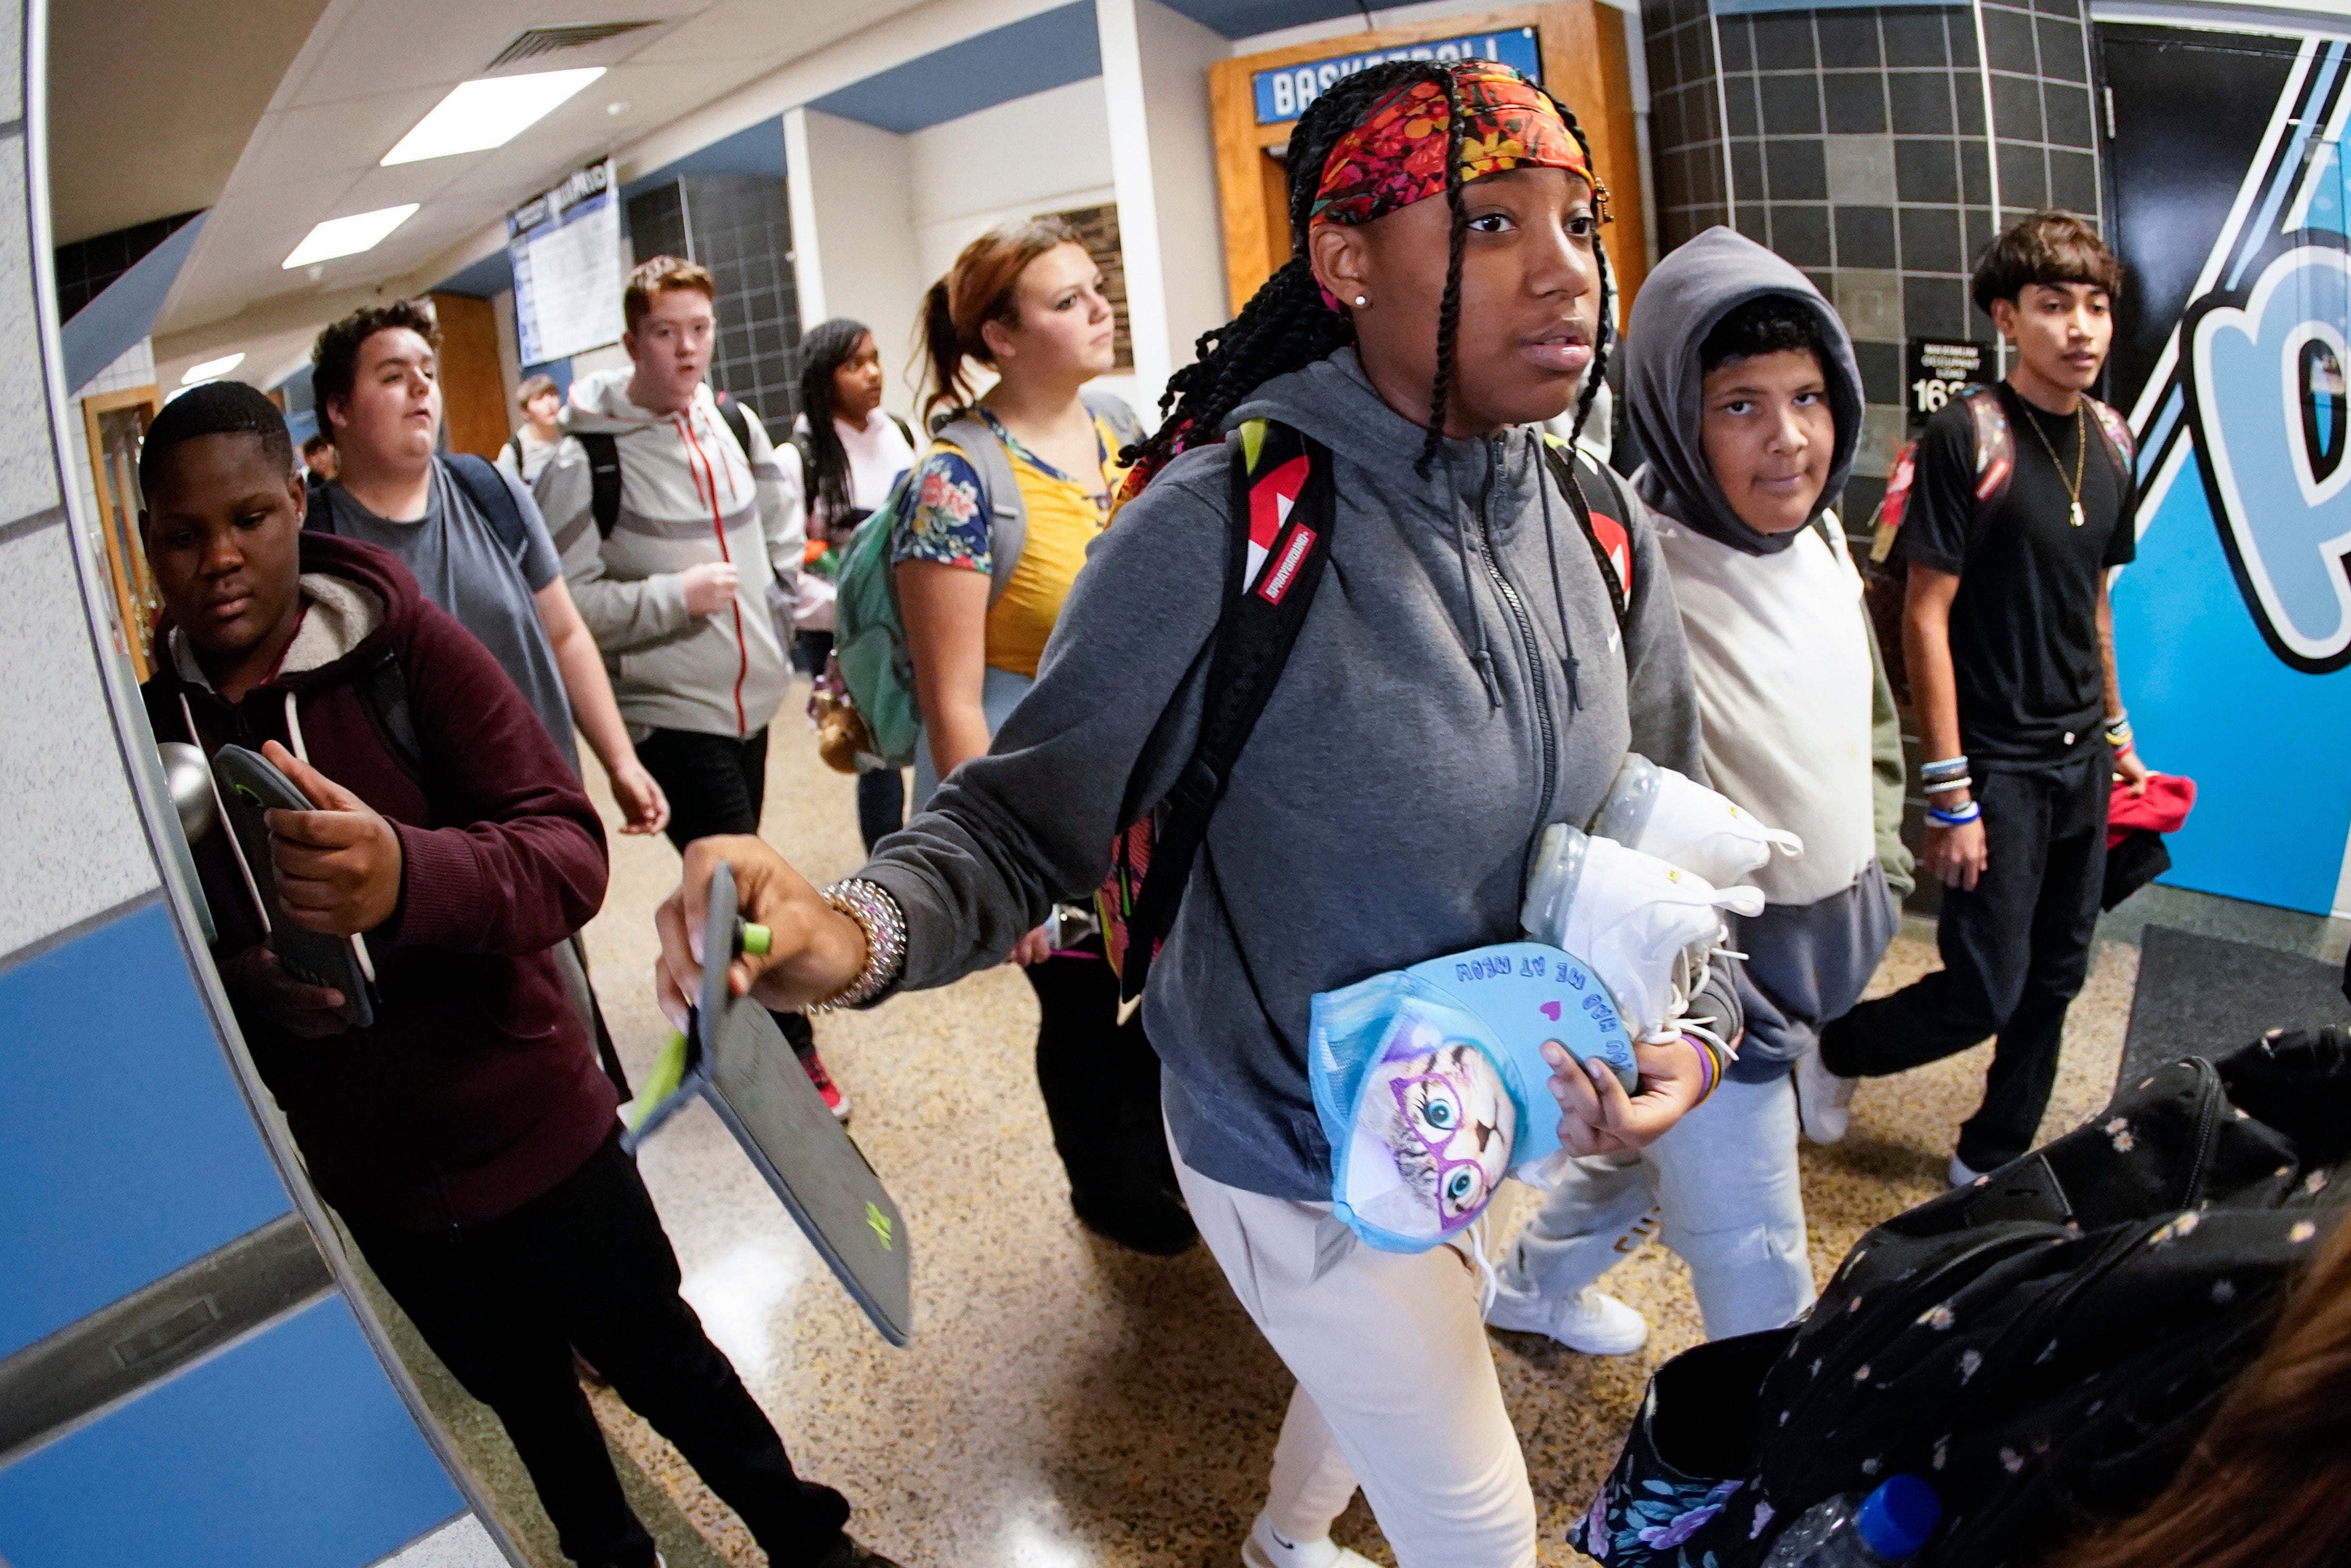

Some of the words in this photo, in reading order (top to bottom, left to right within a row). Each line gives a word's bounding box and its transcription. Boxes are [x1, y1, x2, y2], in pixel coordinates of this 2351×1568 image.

[1455, 955, 1512, 982] MEOW
[1519, 956, 1546, 977] AT
[1555, 962, 1586, 991] ME
[1582, 994, 1617, 1033] HAD
